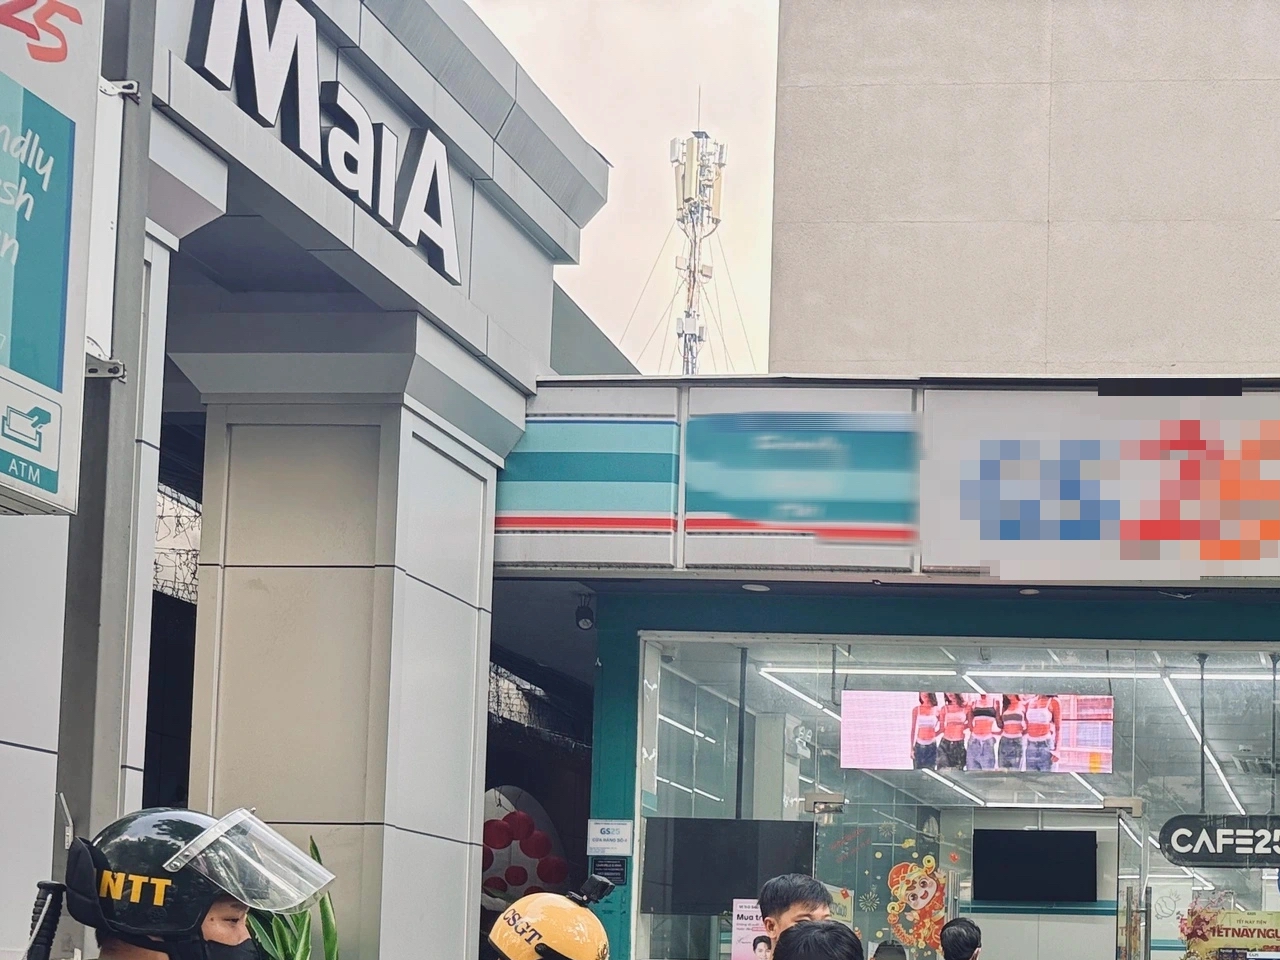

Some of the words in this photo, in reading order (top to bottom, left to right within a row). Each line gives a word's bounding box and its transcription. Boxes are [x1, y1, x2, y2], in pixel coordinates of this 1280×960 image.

[8, 459, 41, 486] ATM
[600, 827, 621, 835] GS25
[99, 869, 172, 907] NTT
[503, 908, 543, 946] CSGT
[736, 913, 754, 921] Mua
